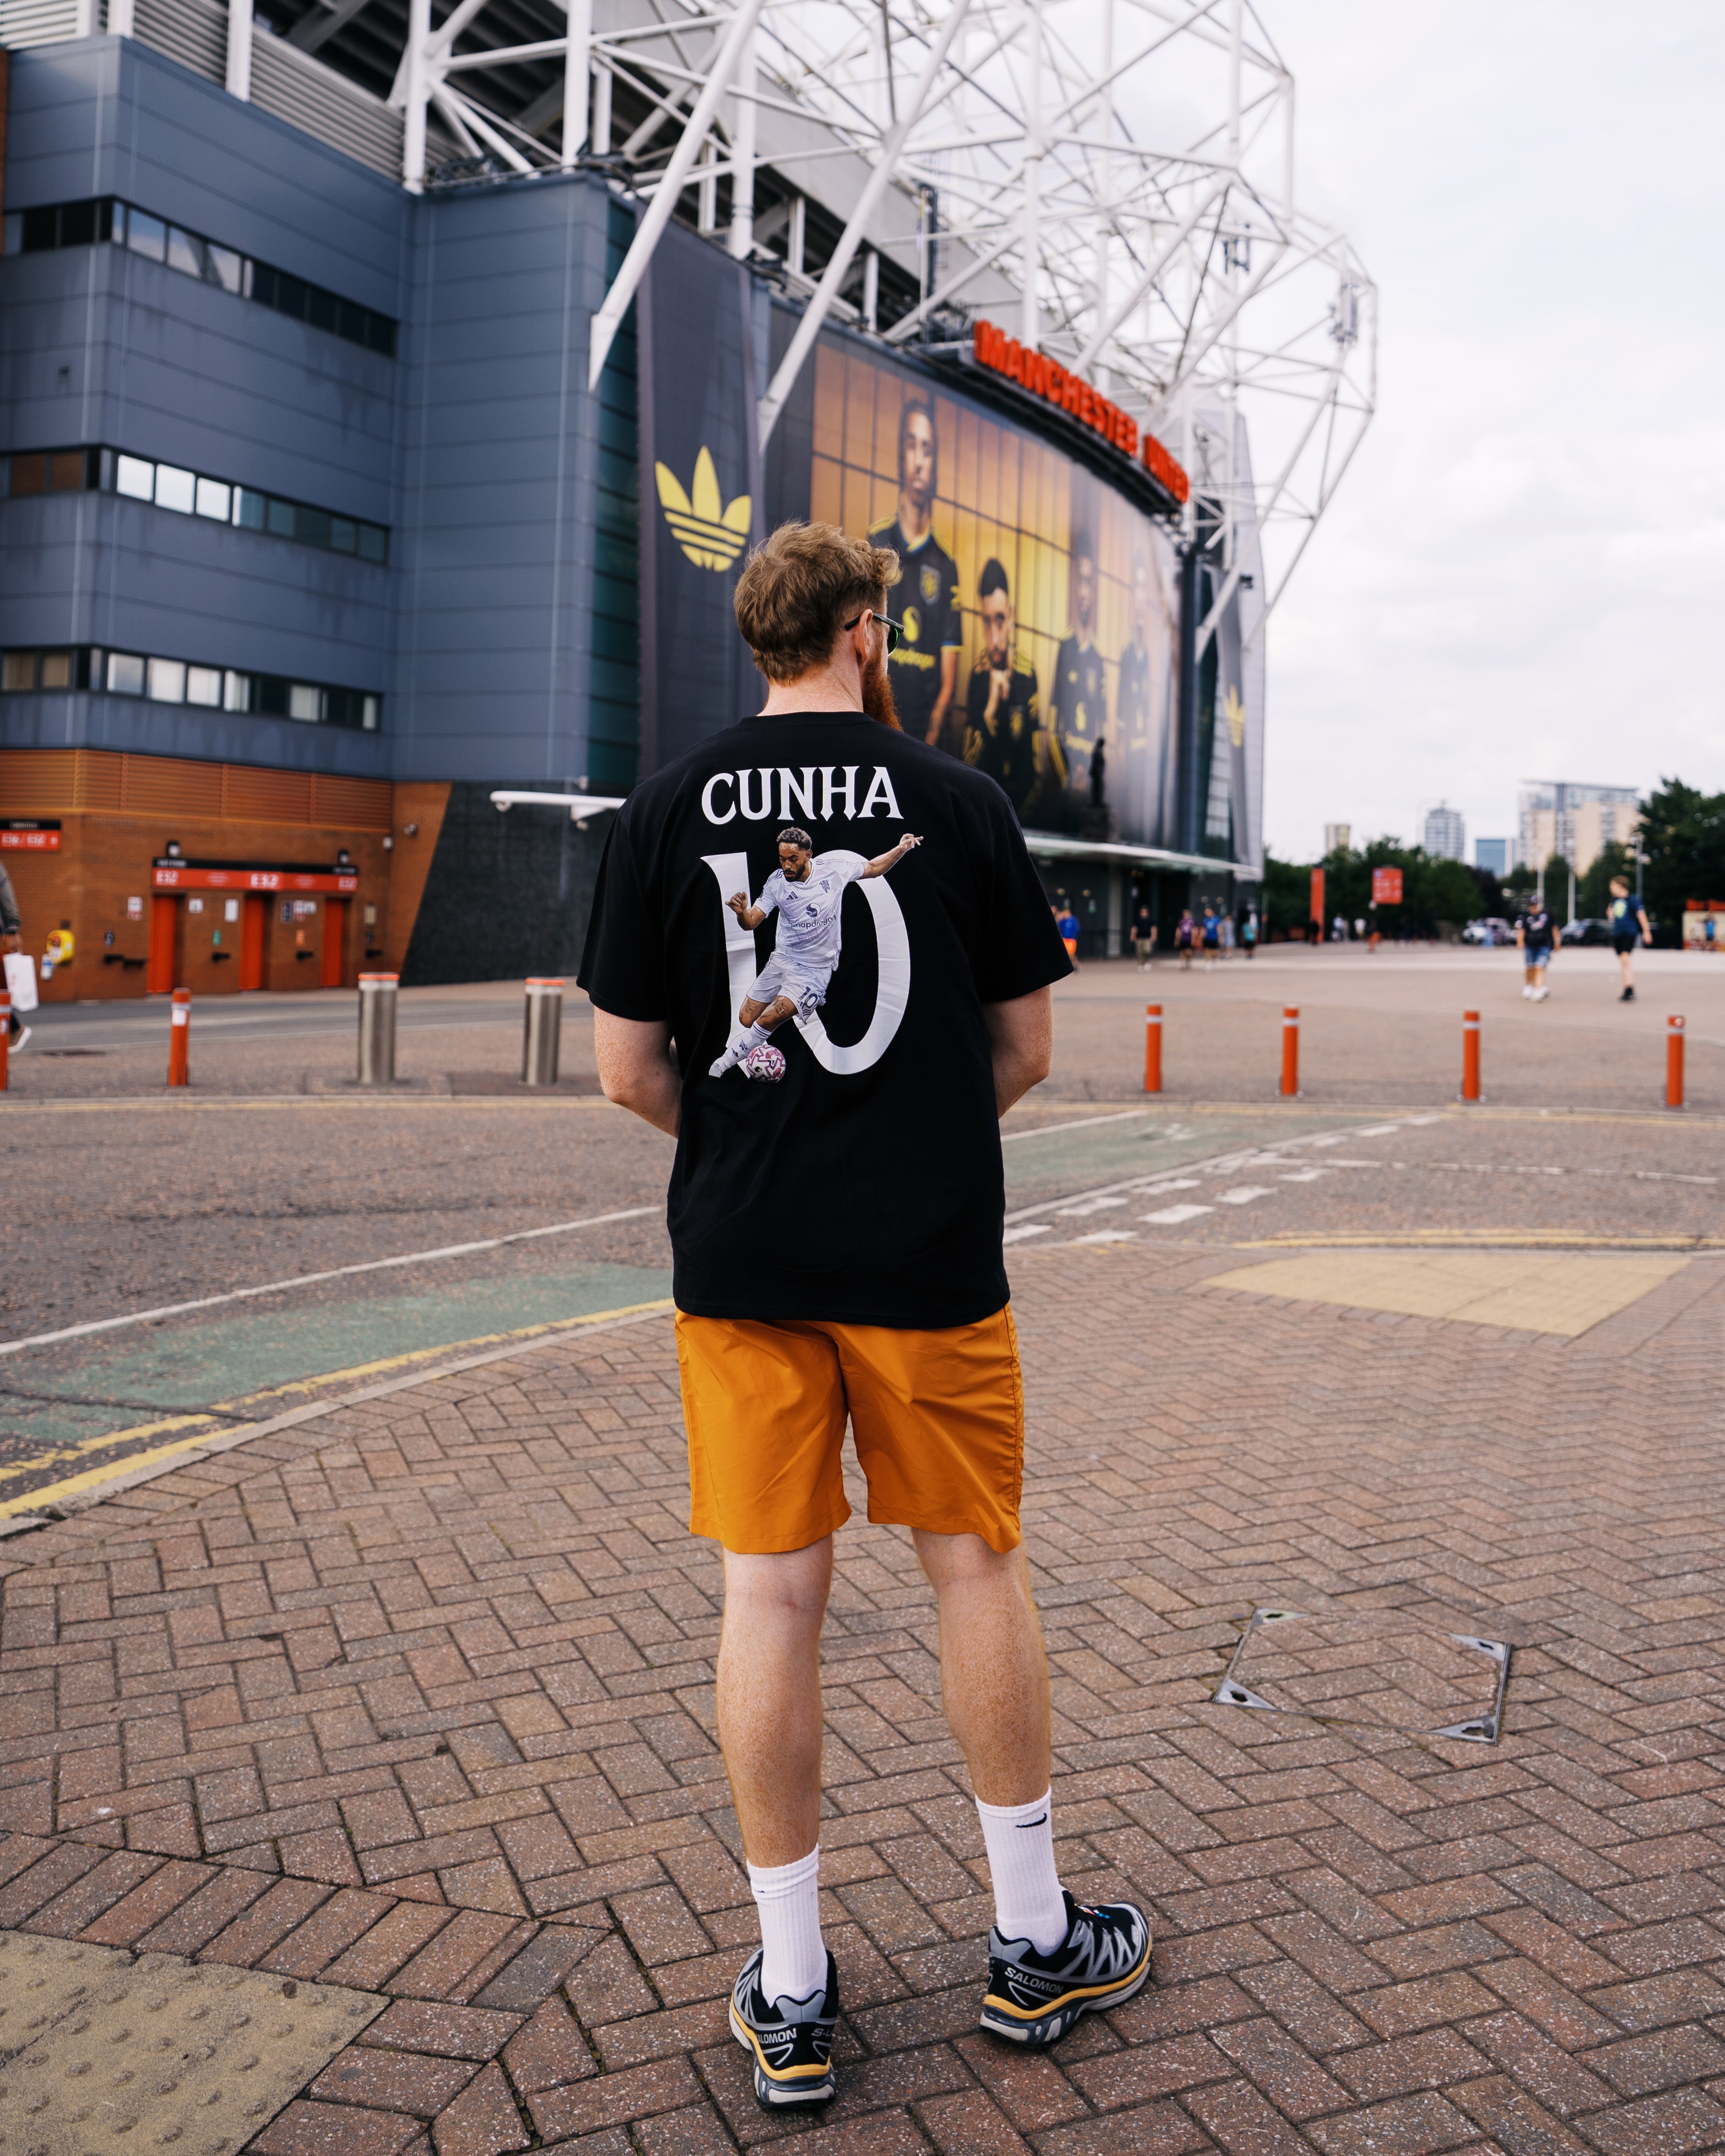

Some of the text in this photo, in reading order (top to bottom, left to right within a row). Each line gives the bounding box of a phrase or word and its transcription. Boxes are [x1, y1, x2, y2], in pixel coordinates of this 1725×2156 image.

[701, 766, 904, 825] CUNHA
[250, 873, 280, 889] E32
[700, 850, 911, 1078] 10
[799, 986, 818, 1008] 10
[1004, 1967, 1064, 1994] SALOMON
[756, 2028, 797, 2044] ALOMON
